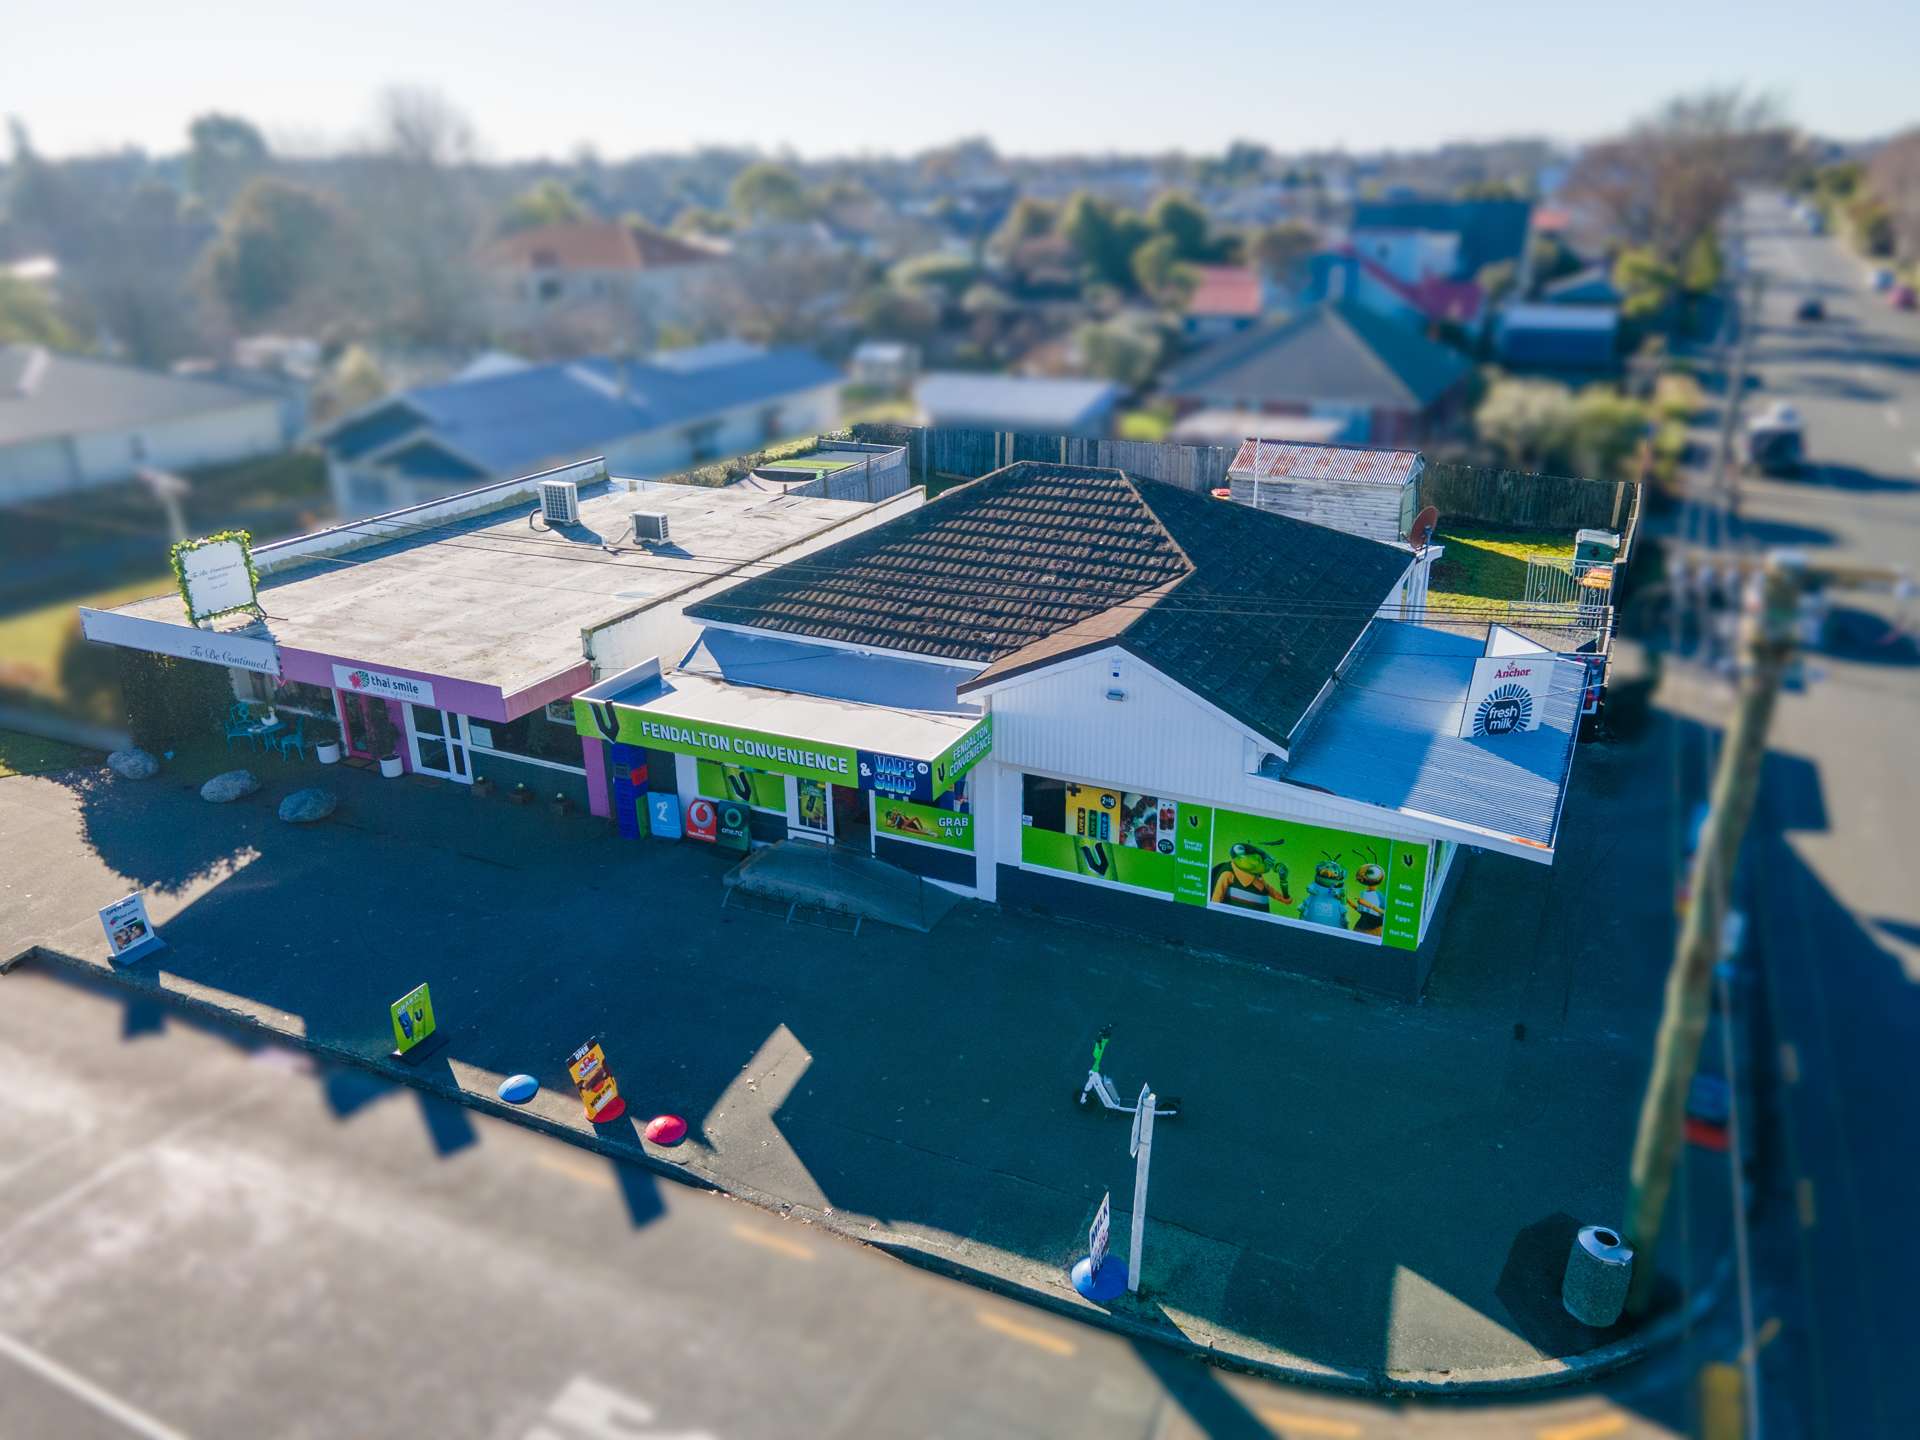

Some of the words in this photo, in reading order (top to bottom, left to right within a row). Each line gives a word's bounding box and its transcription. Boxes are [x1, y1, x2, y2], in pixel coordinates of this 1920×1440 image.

[190, 645, 202, 657] To
[205, 648, 220, 661] Be
[1494, 667, 1531, 679] Anchor
[370, 675, 391, 689] thai
[392, 681, 419, 694] smile
[1489, 705, 1518, 719] fresh
[1489, 718, 1512, 730] milk
[641, 720, 731, 752] FENDALTON
[733, 738, 849, 774] CONVENIENCE
[952, 727, 989, 758] FENDALTON
[949, 735, 992, 776] CONVENIENCE
[860, 763, 872, 777] &
[873, 754, 915, 779] VAPE
[873, 774, 916, 796] SHOP
[938, 817, 969, 828] GRAB
[944, 828, 953, 837] A
[106, 905, 122, 916] OPEN
